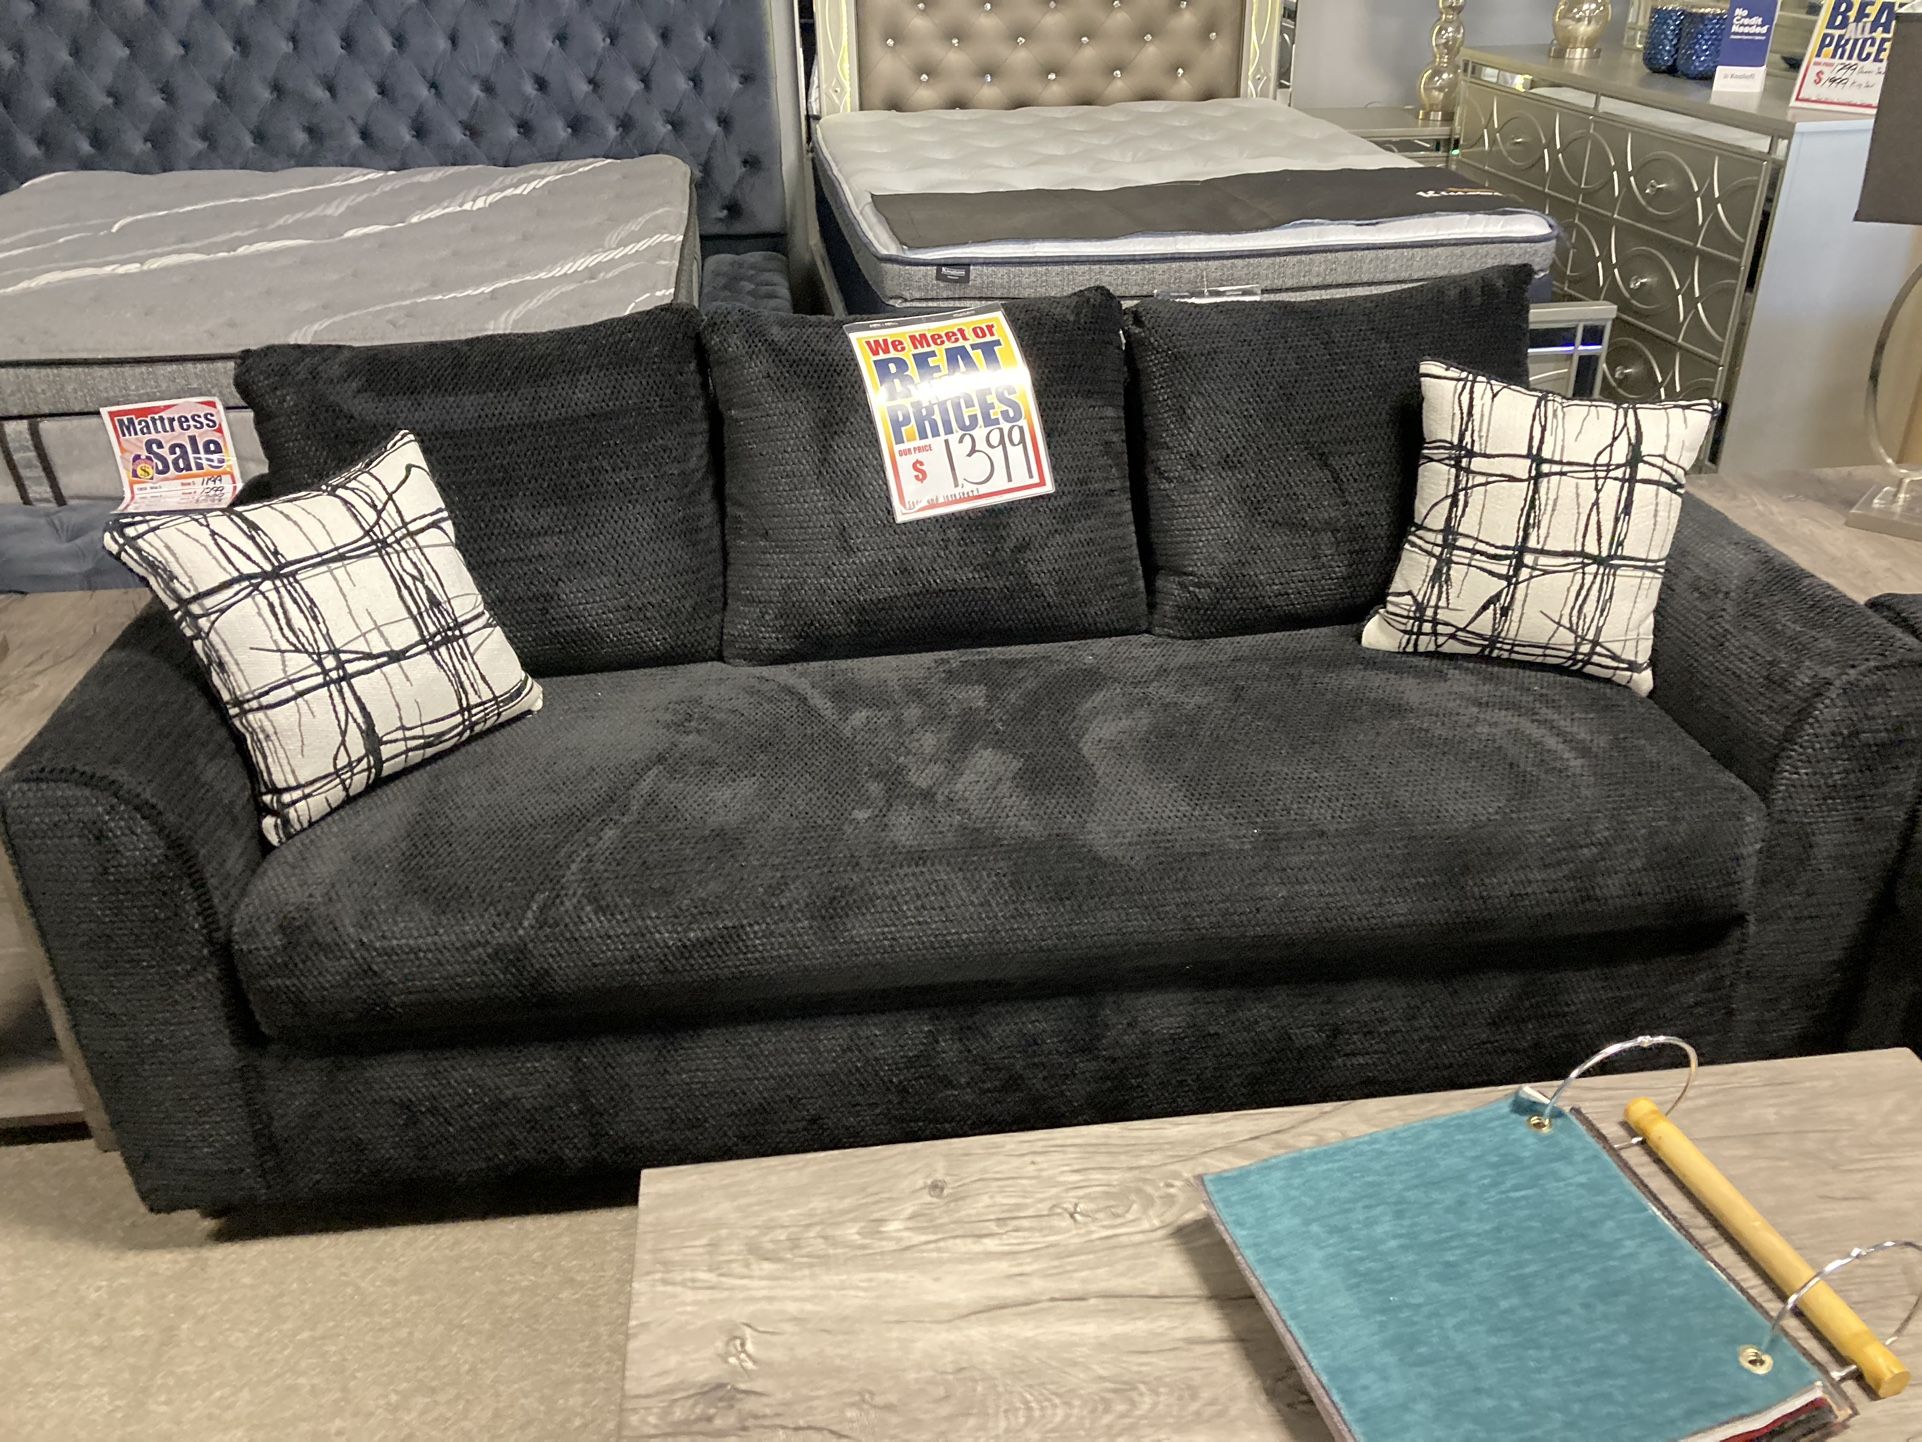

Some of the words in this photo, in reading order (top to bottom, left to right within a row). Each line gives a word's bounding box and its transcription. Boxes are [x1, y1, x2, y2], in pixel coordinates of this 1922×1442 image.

[1733, 16, 1763, 25] Credit
[1734, 8, 1748, 17] No
[1826, 0, 1907, 34] BEA
[1731, 24, 1770, 33] Needed
[1814, 70, 1824, 86] $
[866, 338, 906, 356] We
[909, 327, 970, 349] Meet
[972, 323, 995, 339] or
[873, 339, 1003, 401] BEAT
[116, 412, 217, 438] Mattress
[887, 384, 1024, 445] PRICES
[144, 435, 226, 475] Sale
[898, 447, 913, 457] OUR
[914, 444, 933, 455] PRICE
[912, 459, 928, 484] $
